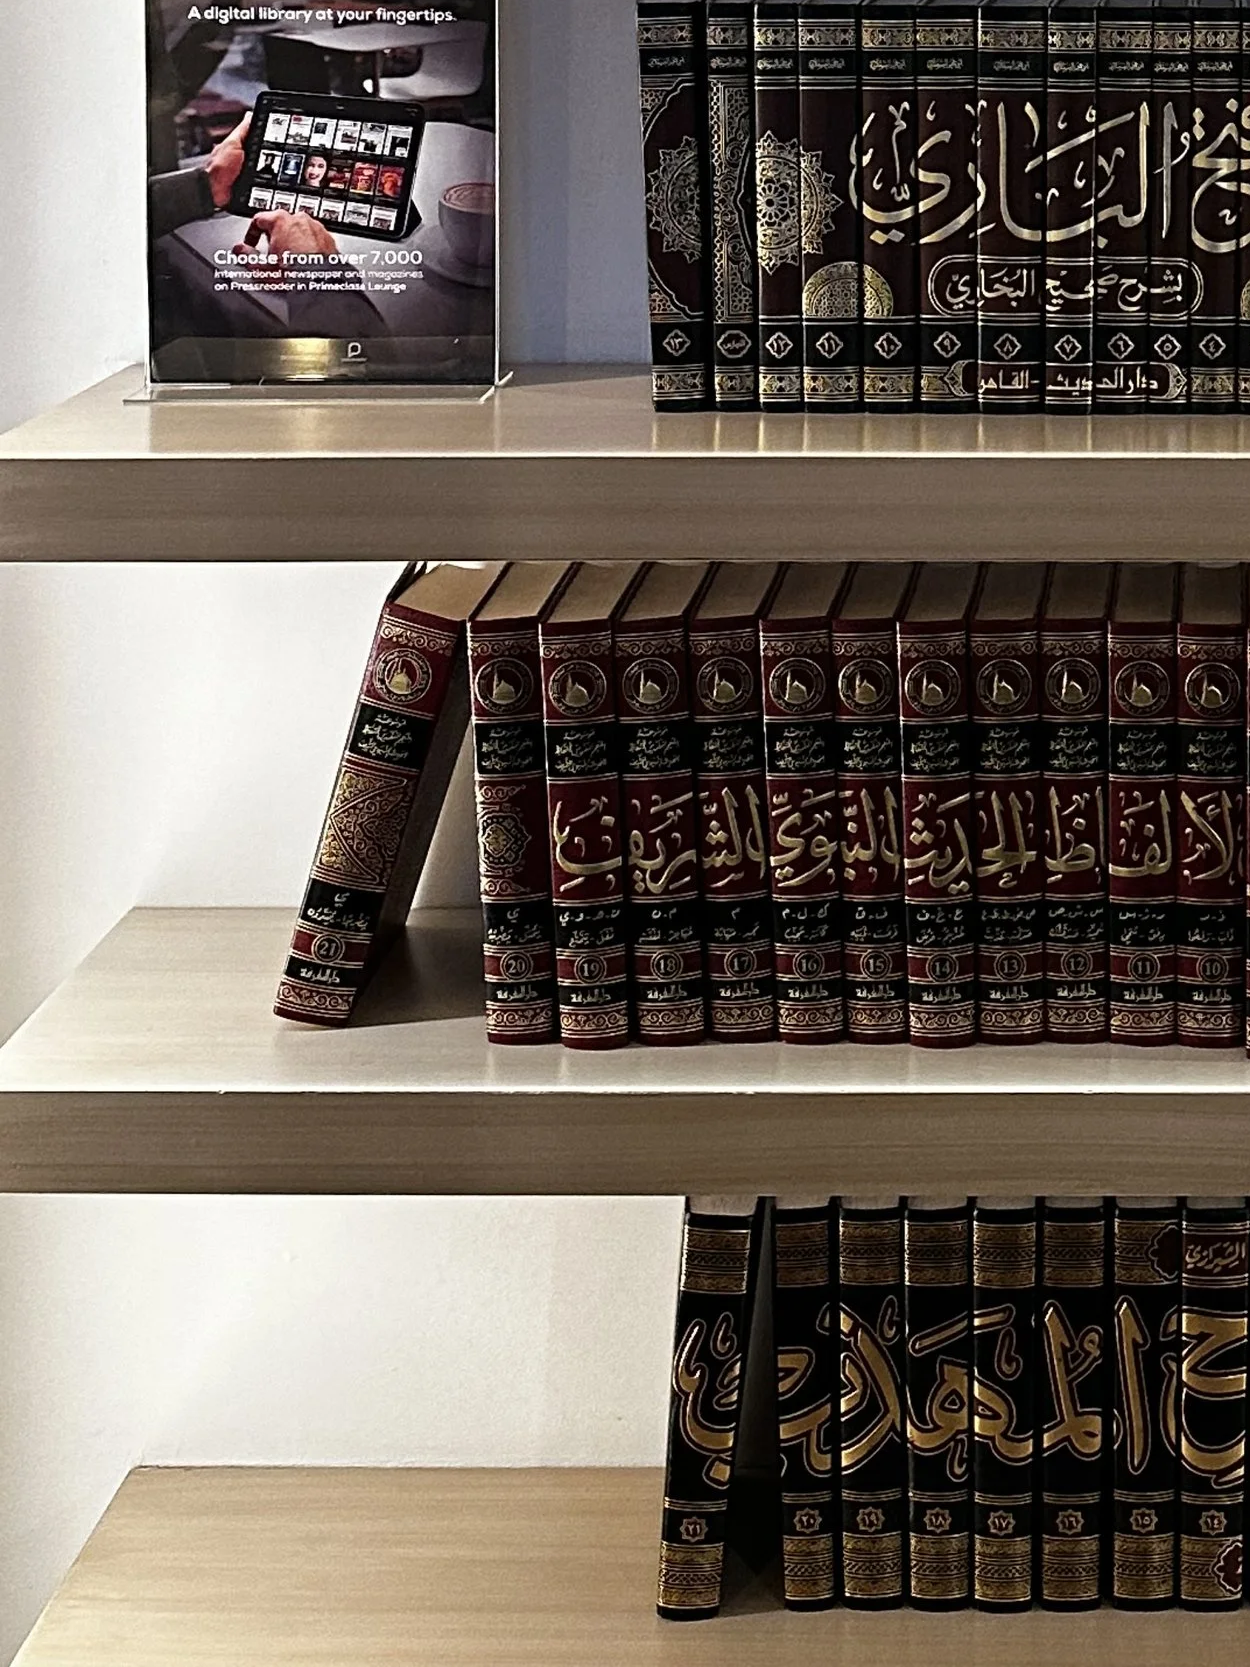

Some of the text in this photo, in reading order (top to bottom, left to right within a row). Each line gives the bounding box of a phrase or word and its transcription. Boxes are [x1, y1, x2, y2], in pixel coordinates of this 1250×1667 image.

[187, 6, 458, 26] A digital library at your fingertips.
[213, 250, 423, 266] Choose from over 7,000
[284, 270, 343, 281] newspaper
[345, 269, 366, 279] and
[367, 270, 424, 281] magazines
[214, 283, 229, 291] on
[230, 282, 295, 291] Pressreader
[296, 282, 308, 291] in
[368, 282, 407, 294] Lounge
[319, 941, 336, 957] 21
[507, 958, 527, 974] 20
[582, 961, 600, 976] 19
[658, 958, 676, 973] 18
[732, 957, 750, 971] 17
[800, 958, 818, 972] 16
[867, 958, 885, 972] 15
[933, 961, 951, 975] 14
[1002, 959, 1019, 973] 13
[1069, 956, 1086, 971] 12
[1136, 961, 1152, 975] 11
[1204, 961, 1221, 975] 10
